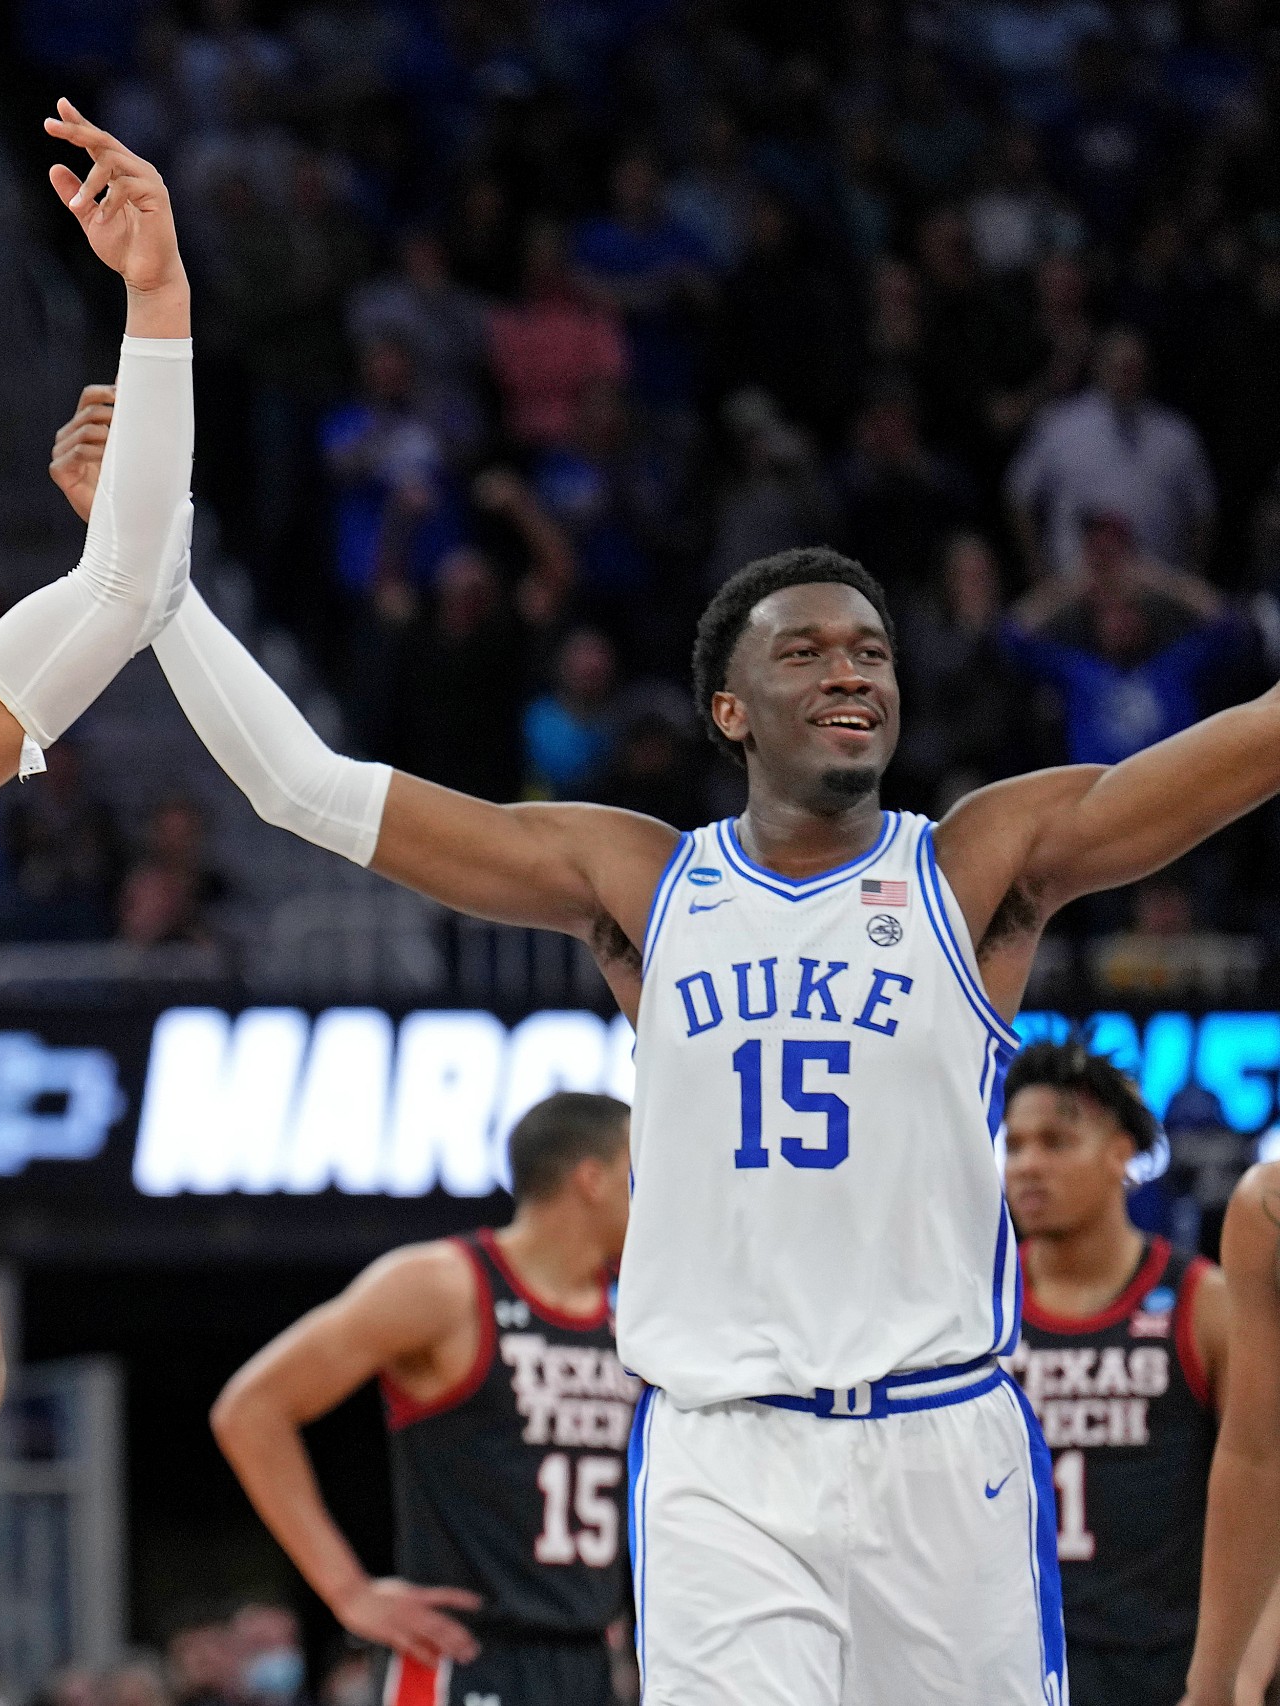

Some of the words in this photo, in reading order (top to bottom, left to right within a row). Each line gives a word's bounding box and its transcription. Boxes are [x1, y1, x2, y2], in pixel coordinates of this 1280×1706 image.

[675, 956, 913, 1037] DUKE
[131, 1005, 634, 1199] MARC
[732, 1039, 851, 1170] 15
[533, 1452, 621, 1568] 15
